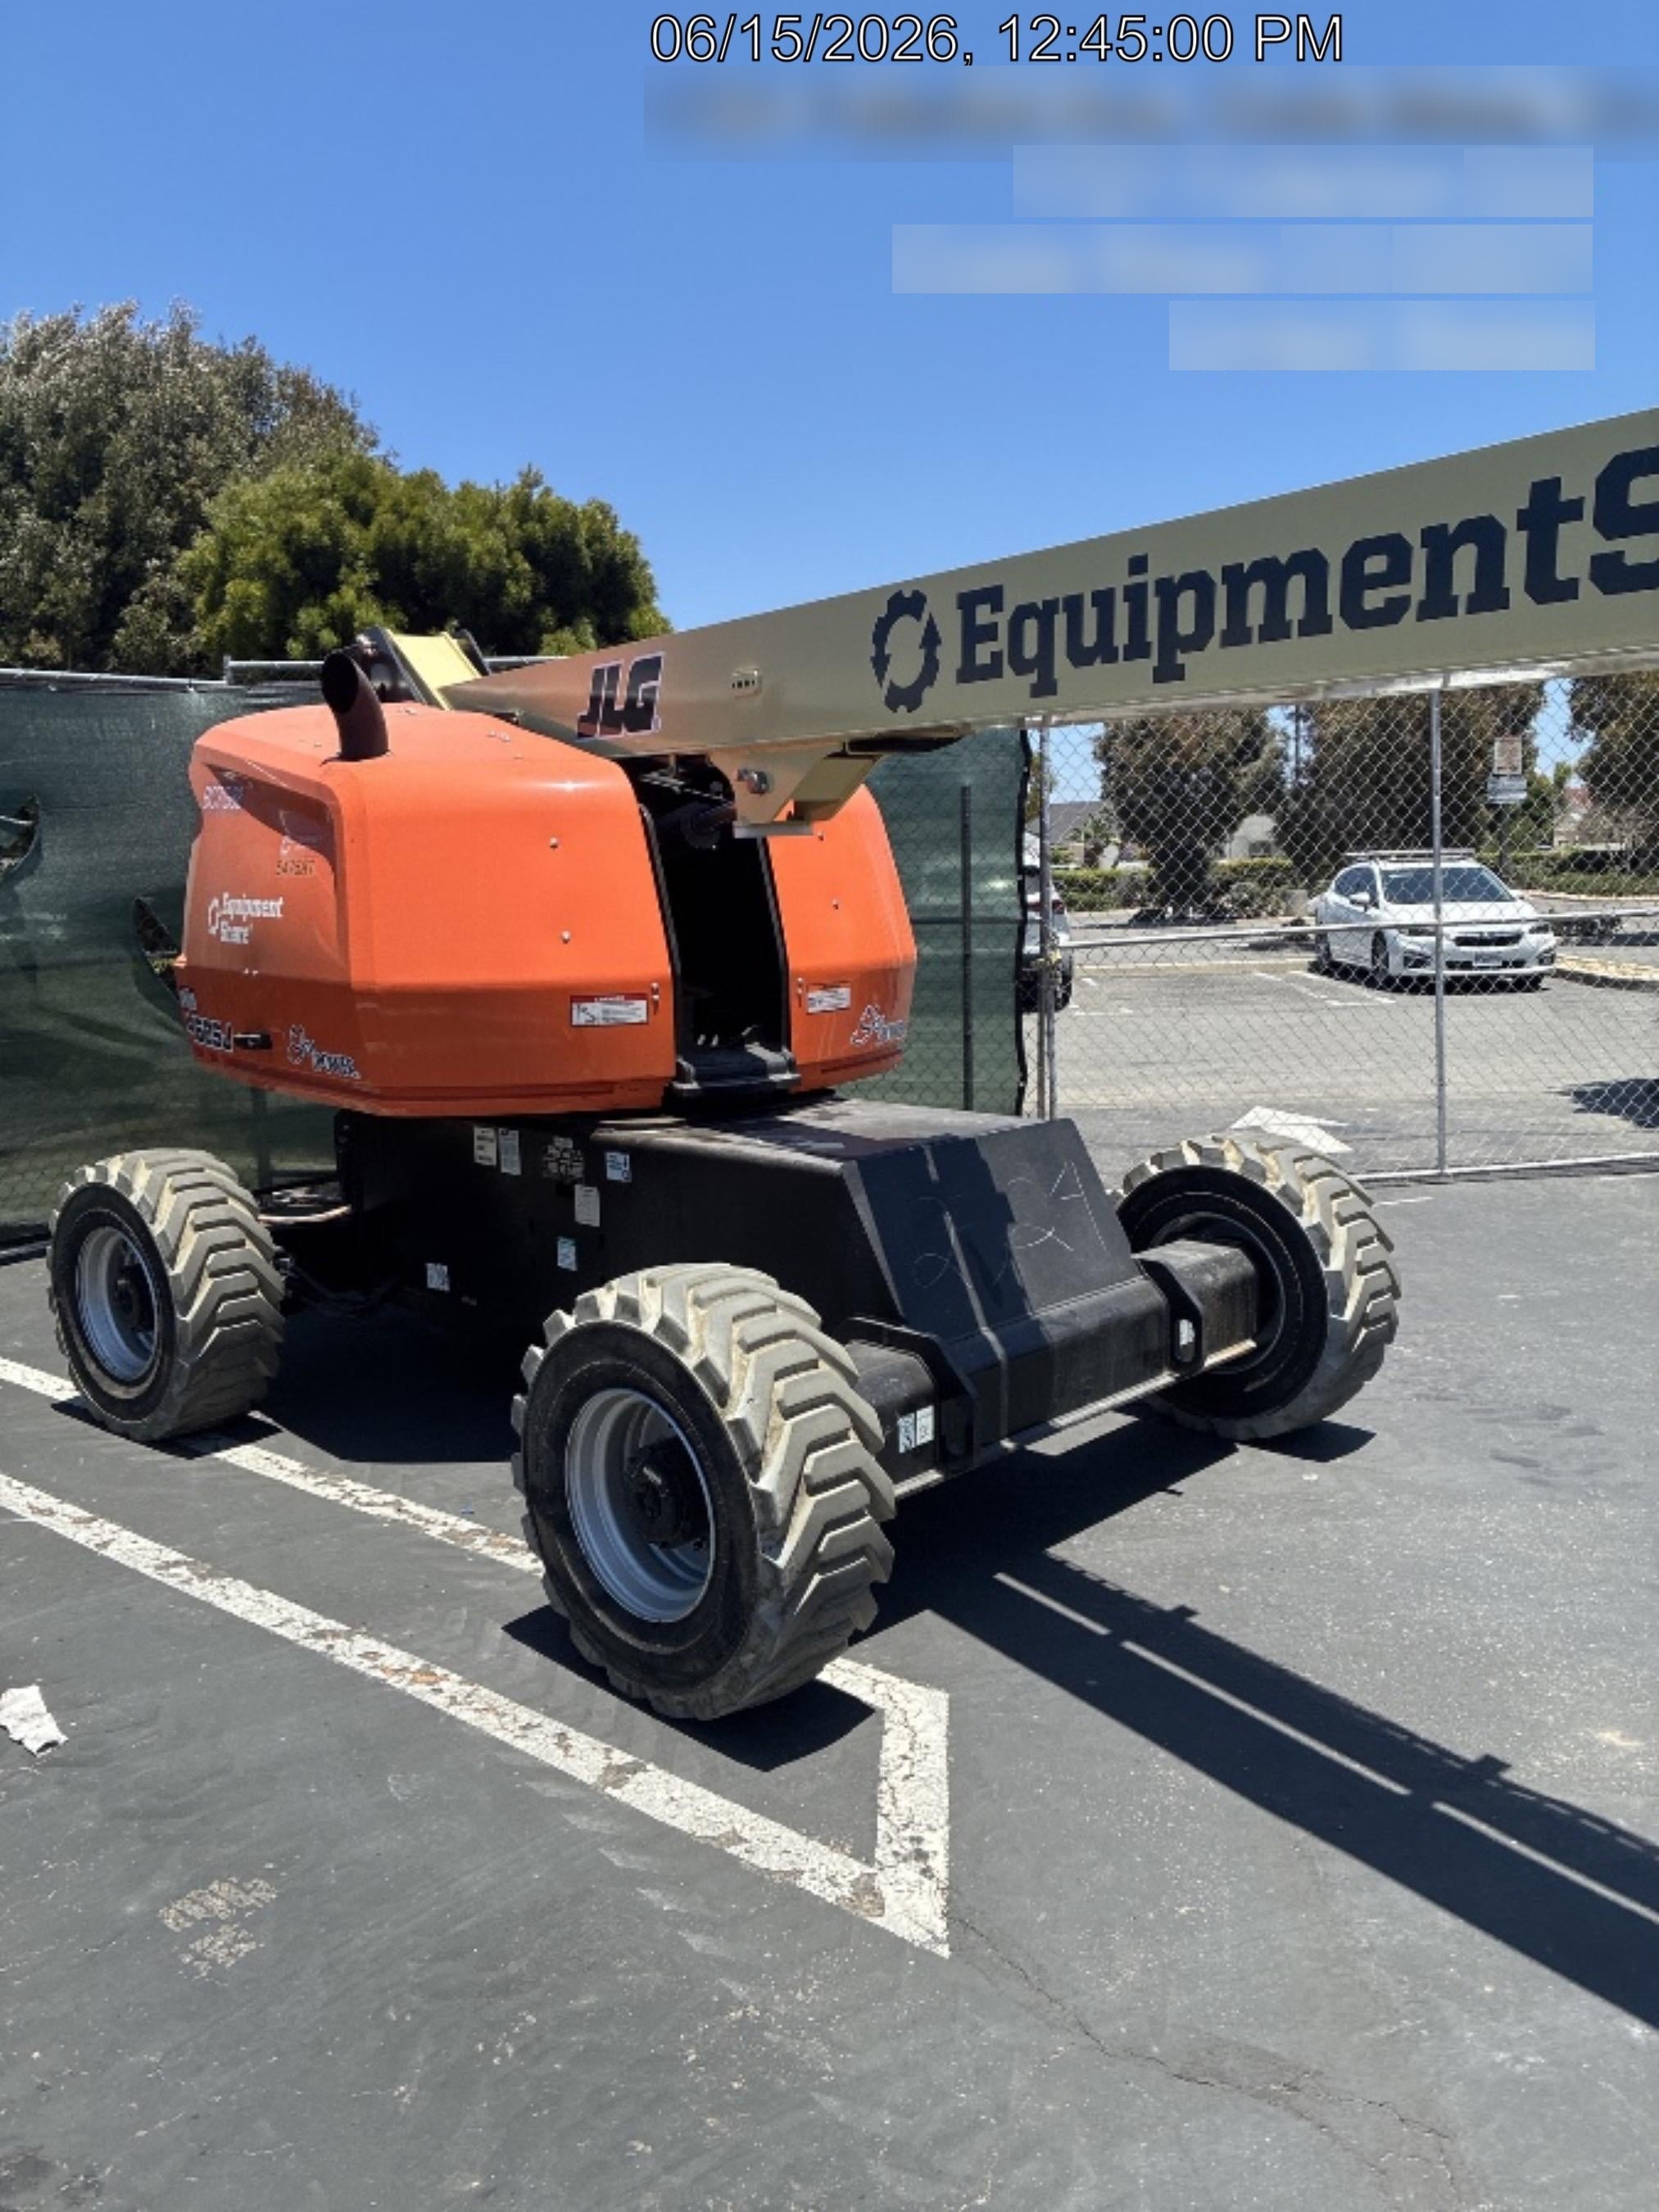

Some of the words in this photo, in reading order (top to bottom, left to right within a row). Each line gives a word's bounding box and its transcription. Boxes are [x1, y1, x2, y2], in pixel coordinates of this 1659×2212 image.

[955, 445, 1659, 700] EquipmentS
[576, 651, 667, 739] JLG
[222, 892, 284, 922] Equipment
